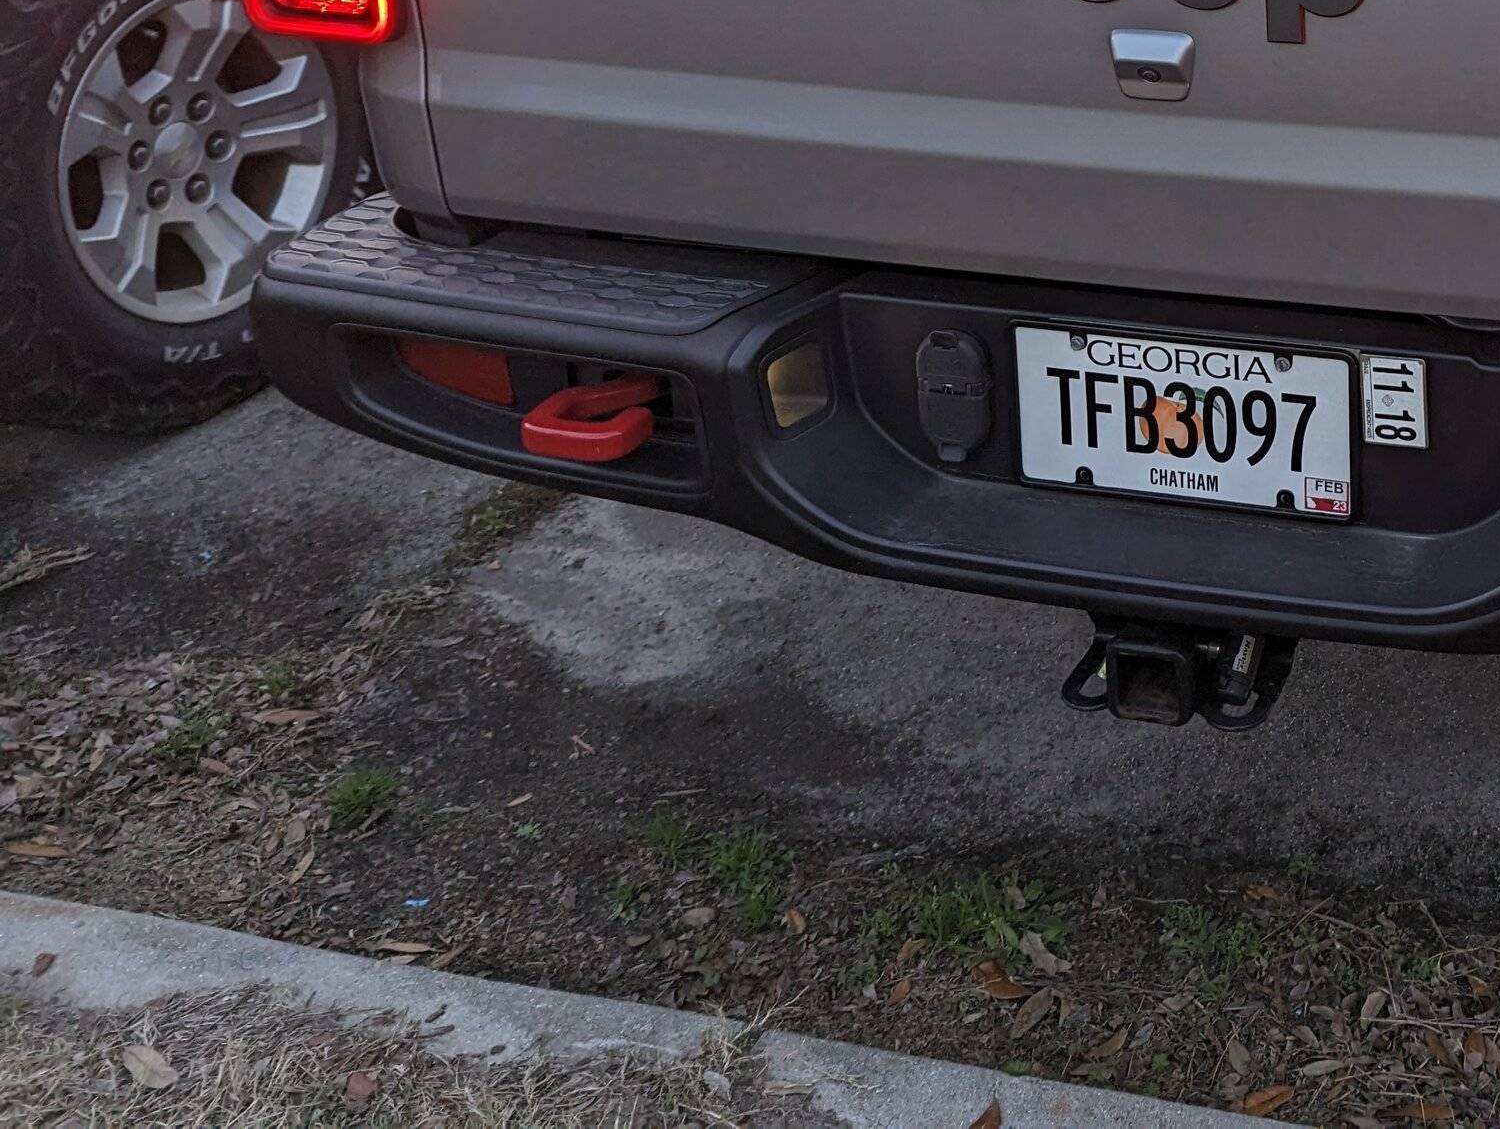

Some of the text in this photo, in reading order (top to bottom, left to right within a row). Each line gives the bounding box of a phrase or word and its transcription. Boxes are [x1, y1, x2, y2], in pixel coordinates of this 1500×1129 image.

[1087, 339, 1273, 383] GEORGIA
[1046, 366, 1317, 473] TFB3097
[1150, 467, 1219, 493] CHATHAM
[1315, 480, 1344, 494] FEB
[1332, 500, 1348, 512] 23
